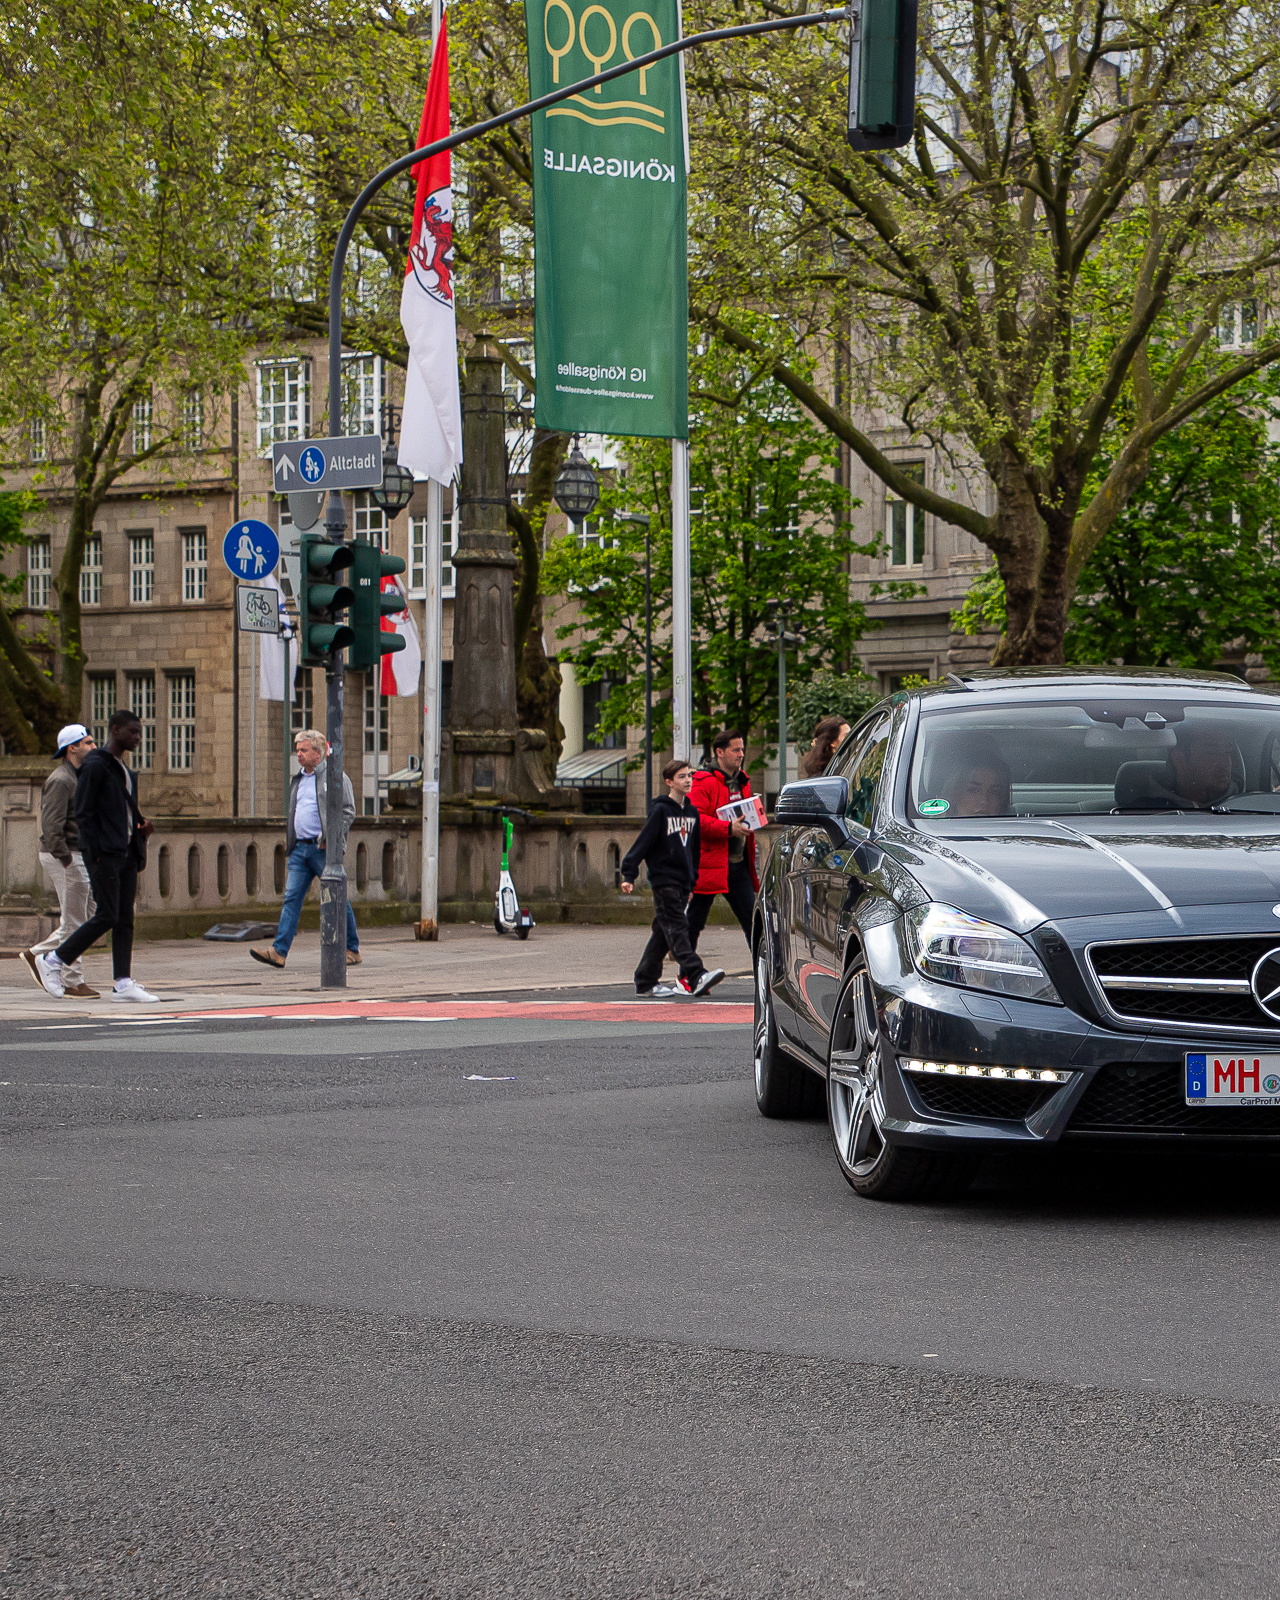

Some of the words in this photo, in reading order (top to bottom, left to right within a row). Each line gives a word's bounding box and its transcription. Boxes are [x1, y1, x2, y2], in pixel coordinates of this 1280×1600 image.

[329, 453, 376, 472] Altstadt
[1213, 1058, 1260, 1093] MH
[1192, 1081, 1201, 1091] D
[1240, 1097, 1273, 1106] CarProf
